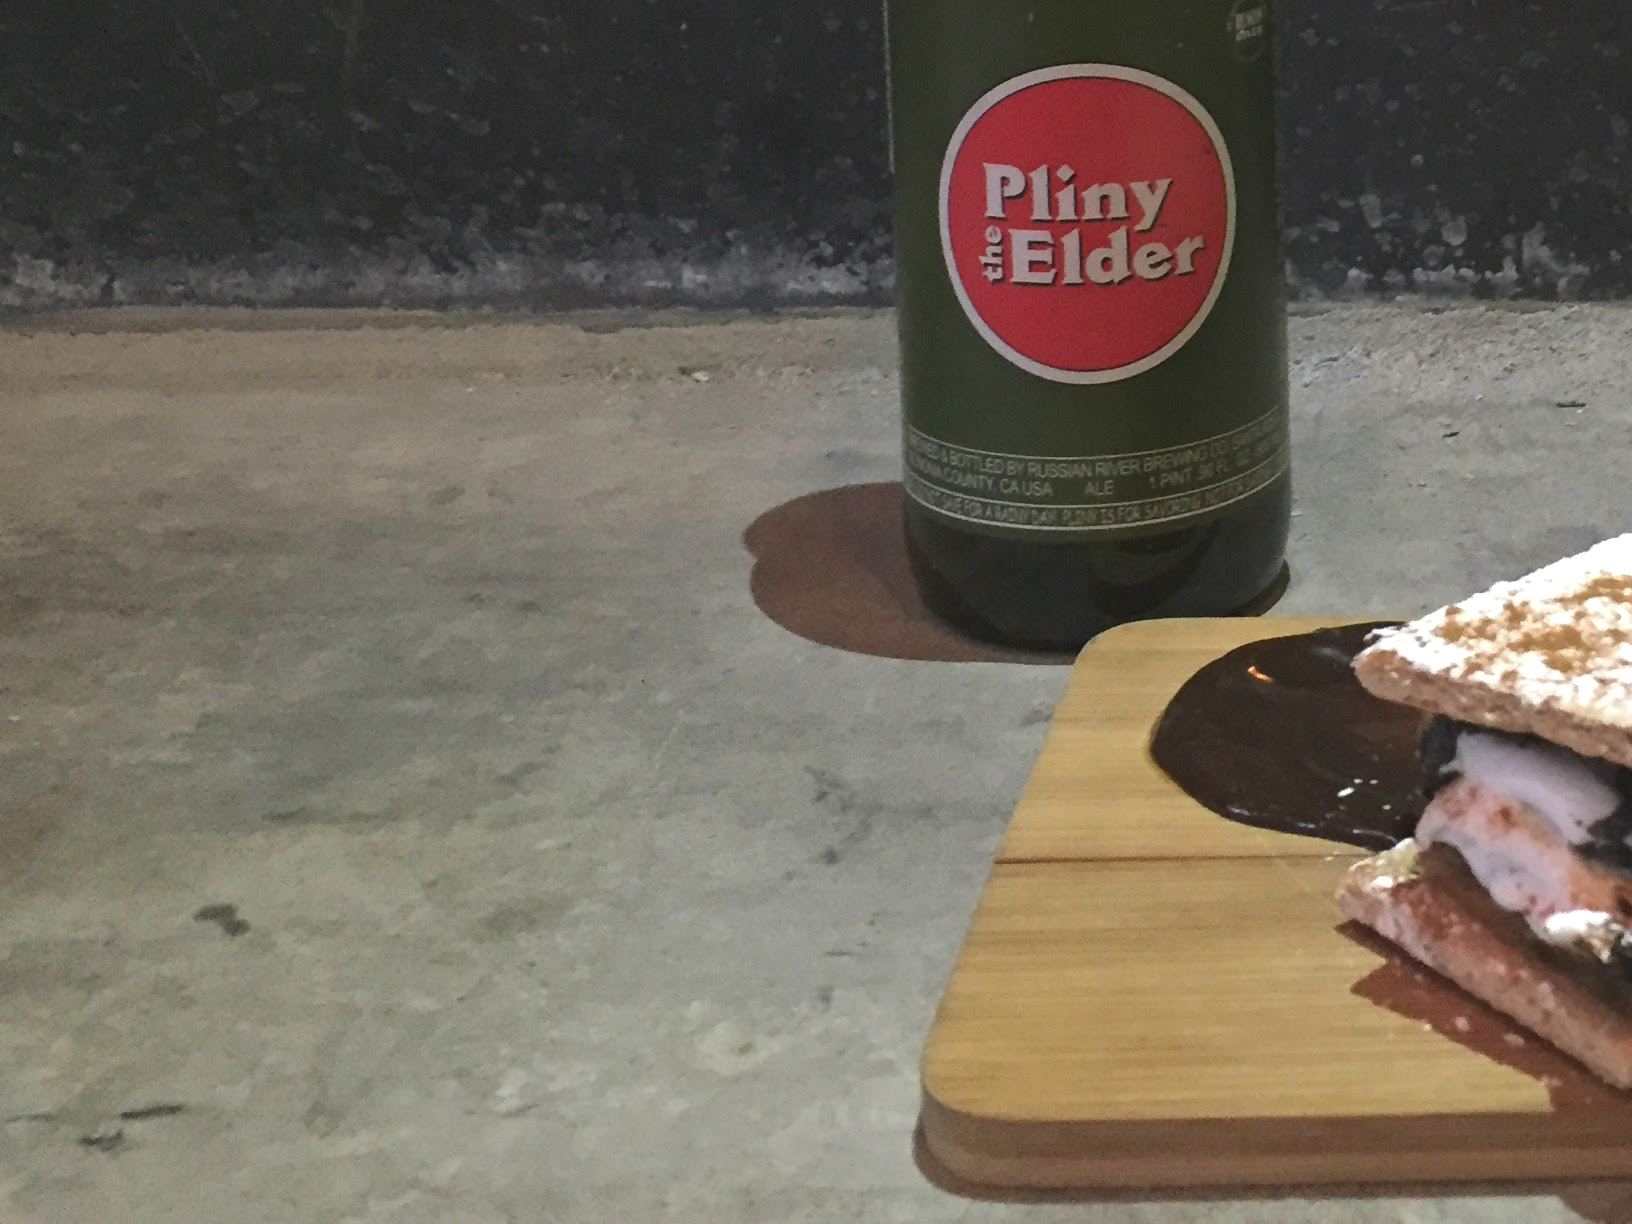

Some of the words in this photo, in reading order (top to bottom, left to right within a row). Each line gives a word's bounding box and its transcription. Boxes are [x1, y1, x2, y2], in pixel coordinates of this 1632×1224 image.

[982, 162, 1173, 233] Pliny
[979, 225, 1005, 283] the
[1008, 227, 1204, 285] Elder
[950, 450, 1004, 474] BOTTLED
[1006, 460, 1025, 476] BY
[1027, 462, 1093, 477] RUSSIAN
[1095, 457, 1142, 476] RIVER
[1143, 444, 1208, 472] BREWING
[999, 477, 1019, 494] CA
[1021, 479, 1053, 495] USA
[1084, 478, 1114, 495] ALE
[1148, 473, 1156, 489] 1
[1159, 466, 1192, 488] PINT
[1100, 506, 1115, 523] IS
[1117, 504, 1140, 522] FOR
